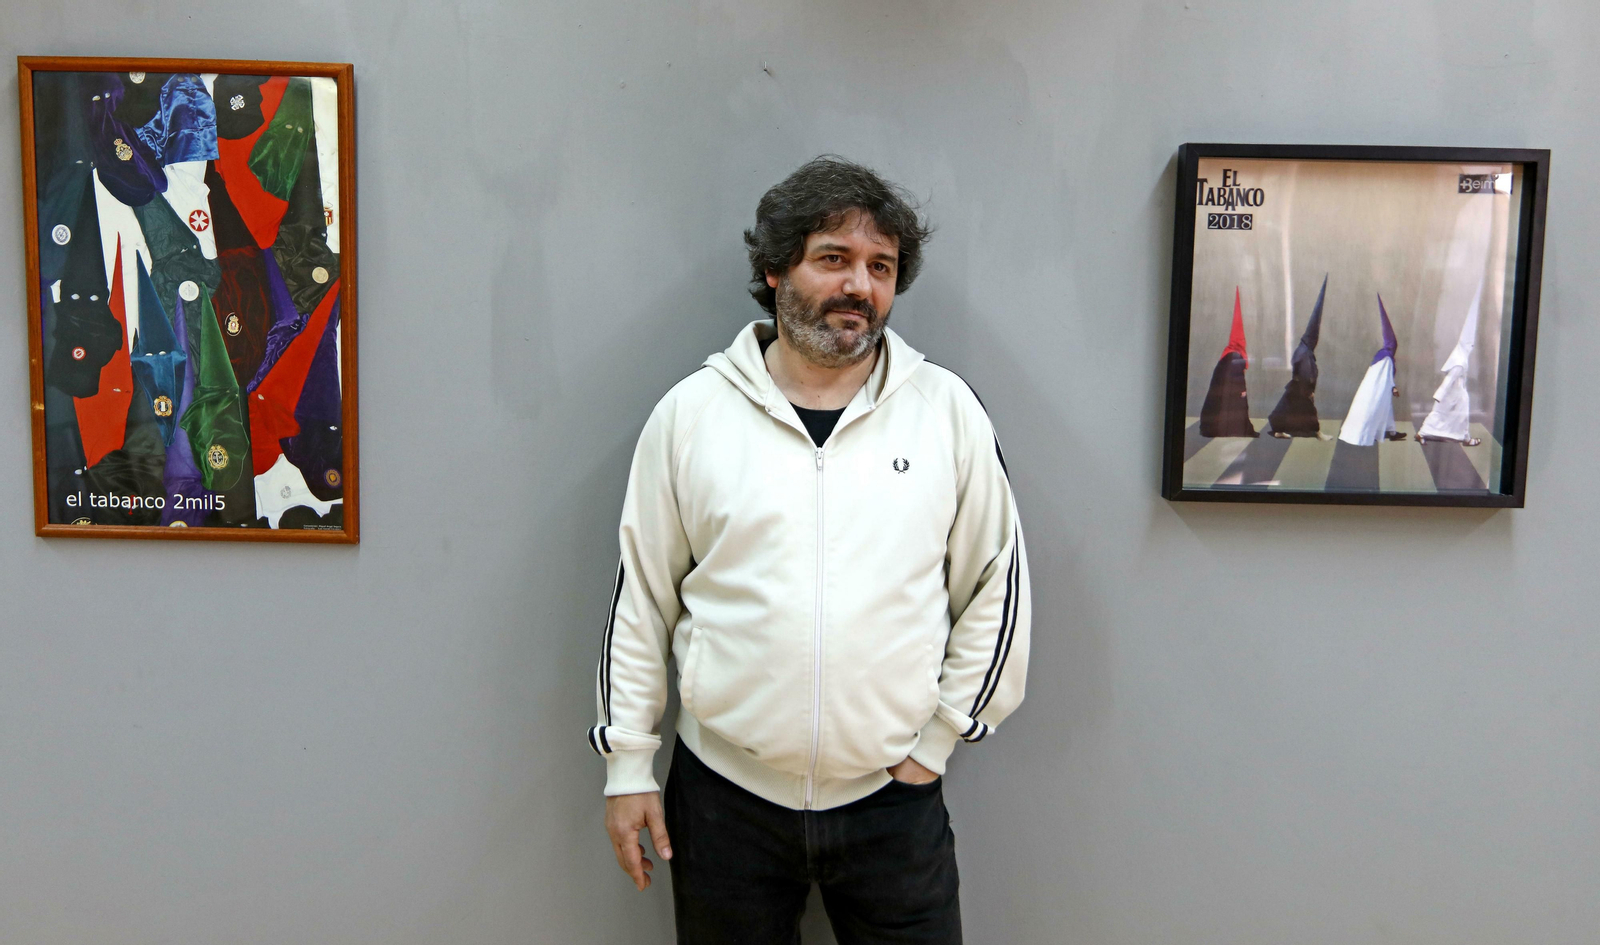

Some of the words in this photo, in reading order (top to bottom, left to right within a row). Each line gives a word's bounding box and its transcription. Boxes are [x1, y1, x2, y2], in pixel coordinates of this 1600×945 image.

[1222, 168, 1241, 188] EL
[1196, 178, 1265, 211] TABANCO
[1208, 214, 1252, 230] 2018
[66, 491, 82, 507] el
[89, 491, 166, 509] tabanco
[173, 493, 226, 511] 2mil5
